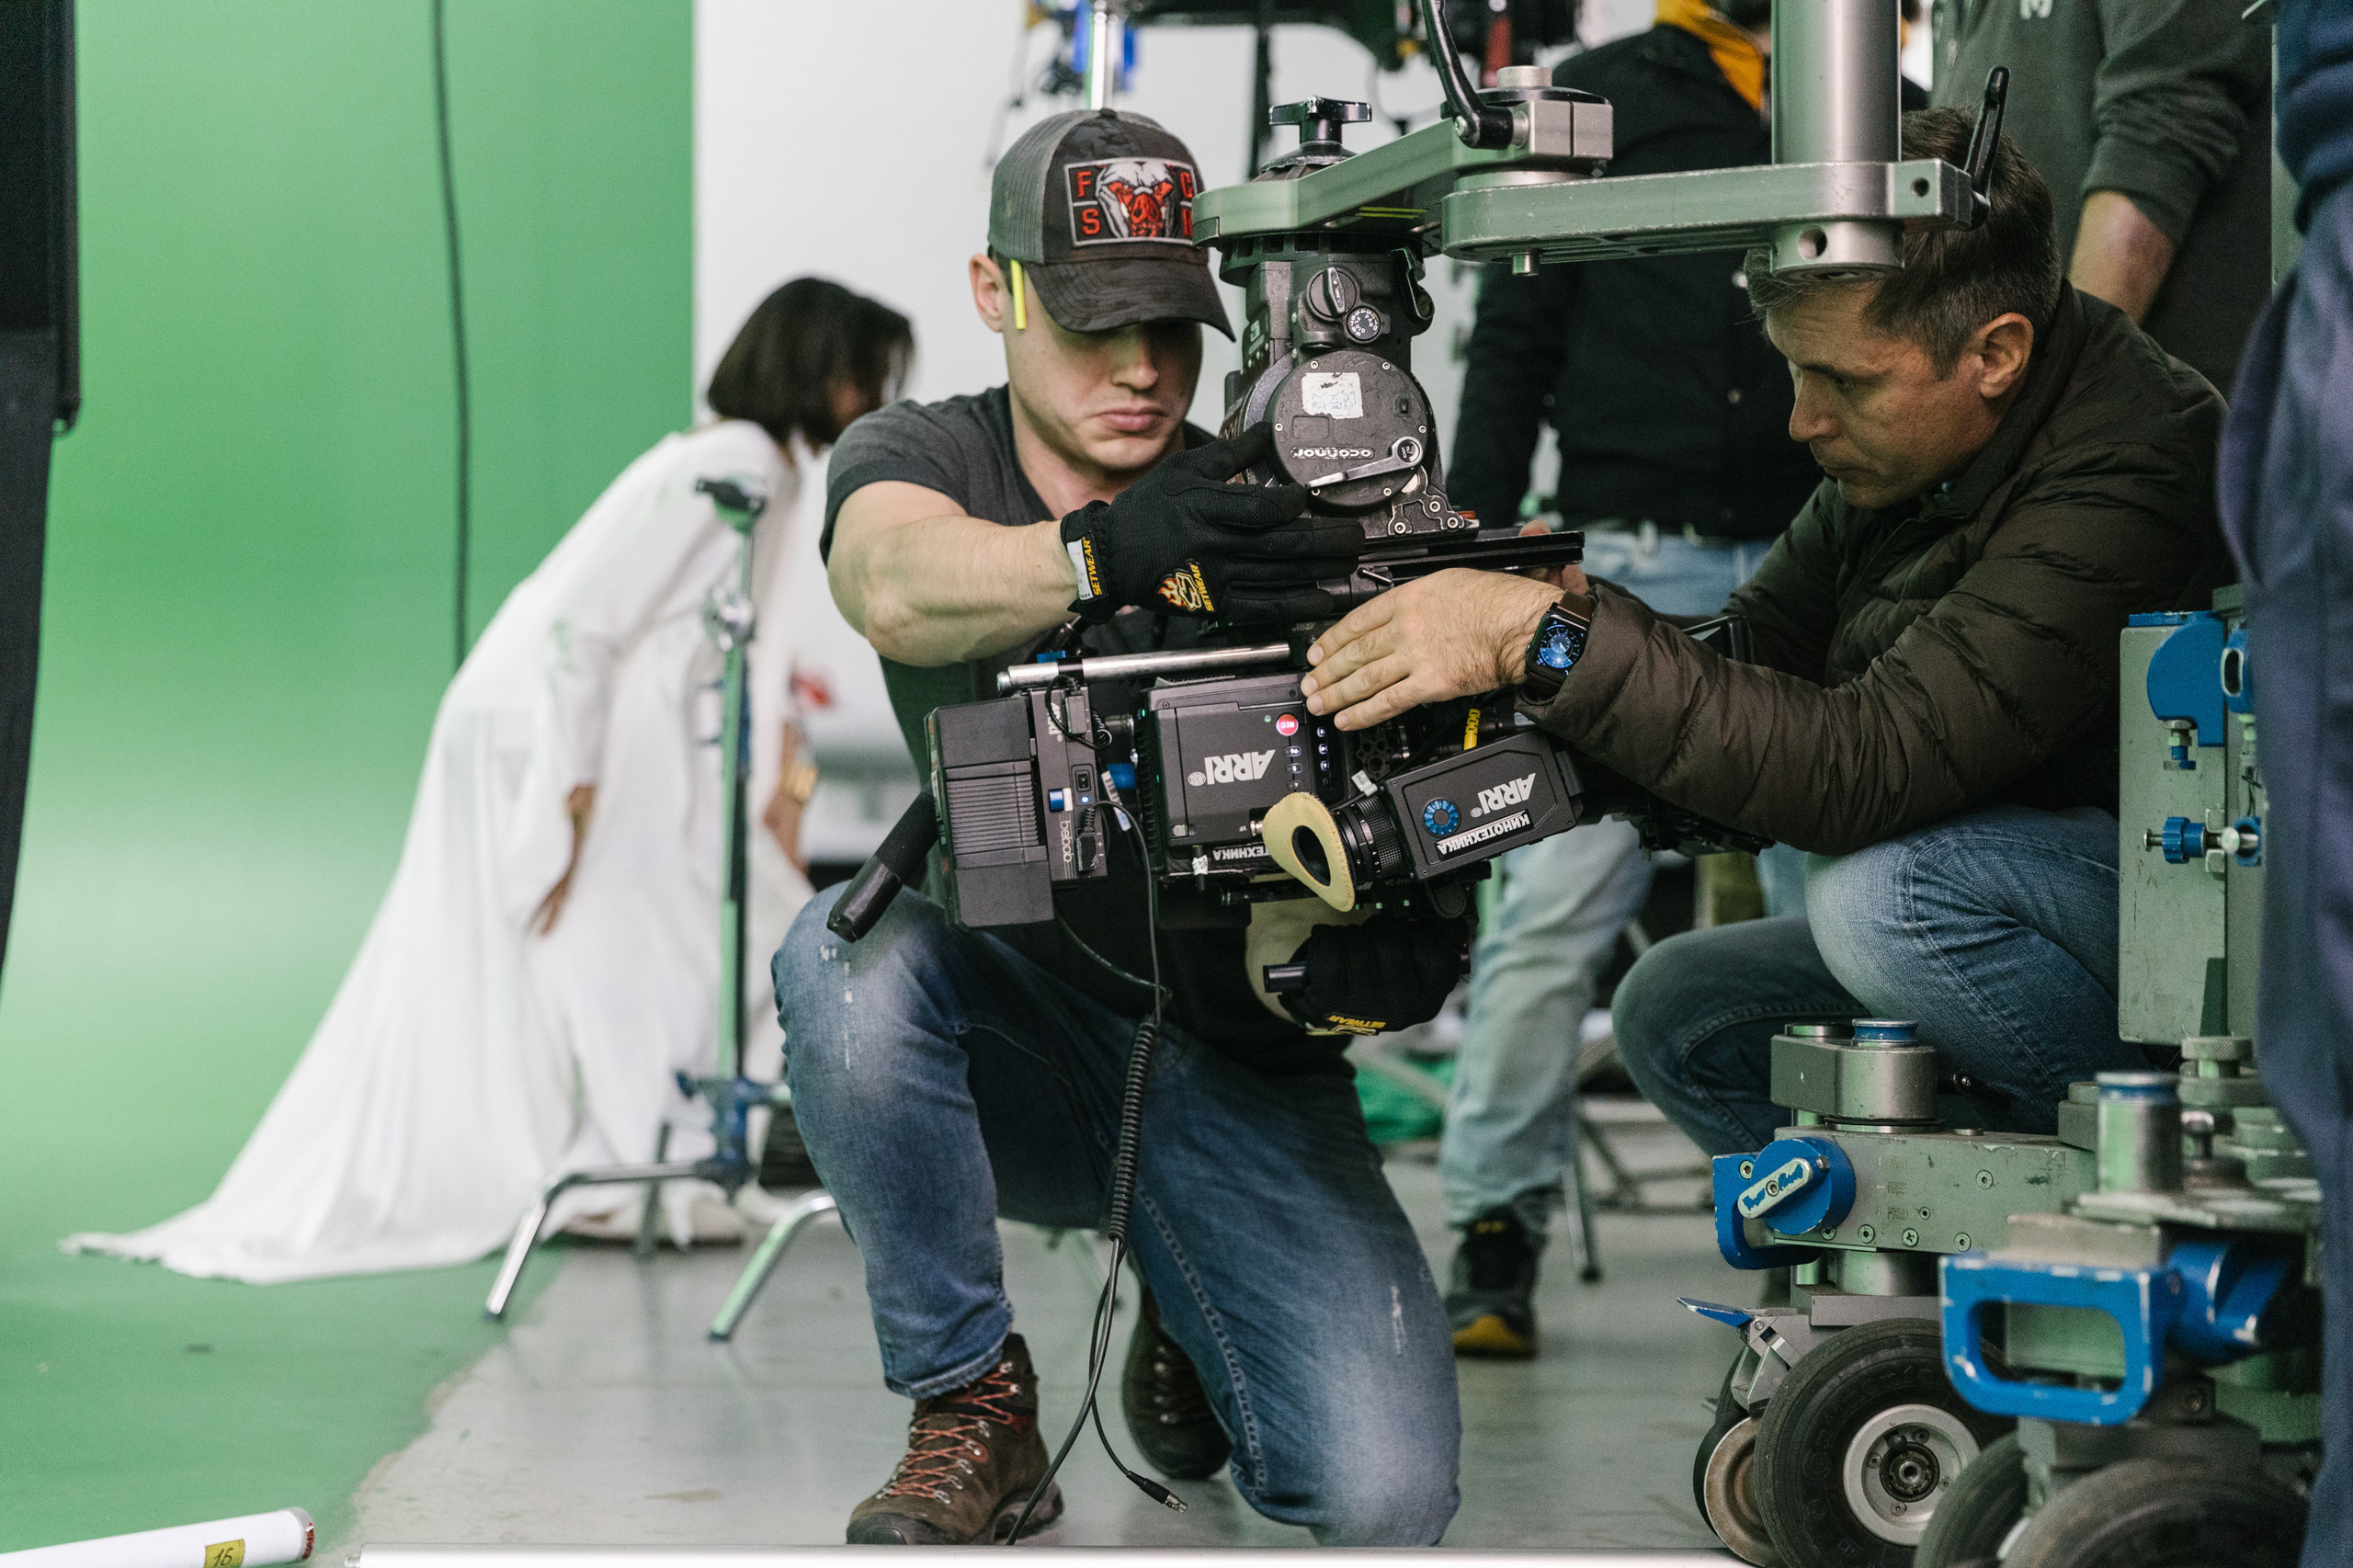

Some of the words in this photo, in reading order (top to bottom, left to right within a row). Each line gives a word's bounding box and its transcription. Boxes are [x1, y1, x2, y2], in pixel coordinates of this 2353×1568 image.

[1075, 171, 1092, 199] F
[1081, 208, 1101, 235] S
[1082, 539, 1103, 597] SETWEAR
[1190, 563, 1215, 612] SETWEAR
[1280, 721, 1295, 729] REC
[1204, 749, 1276, 785] ARRI
[1477, 772, 1536, 814] ARRI
[1060, 820, 1074, 863] bebob
[1212, 846, 1270, 861] ТЕХНИКА
[1437, 813, 1530, 855] КИНОТЕХНИКА
